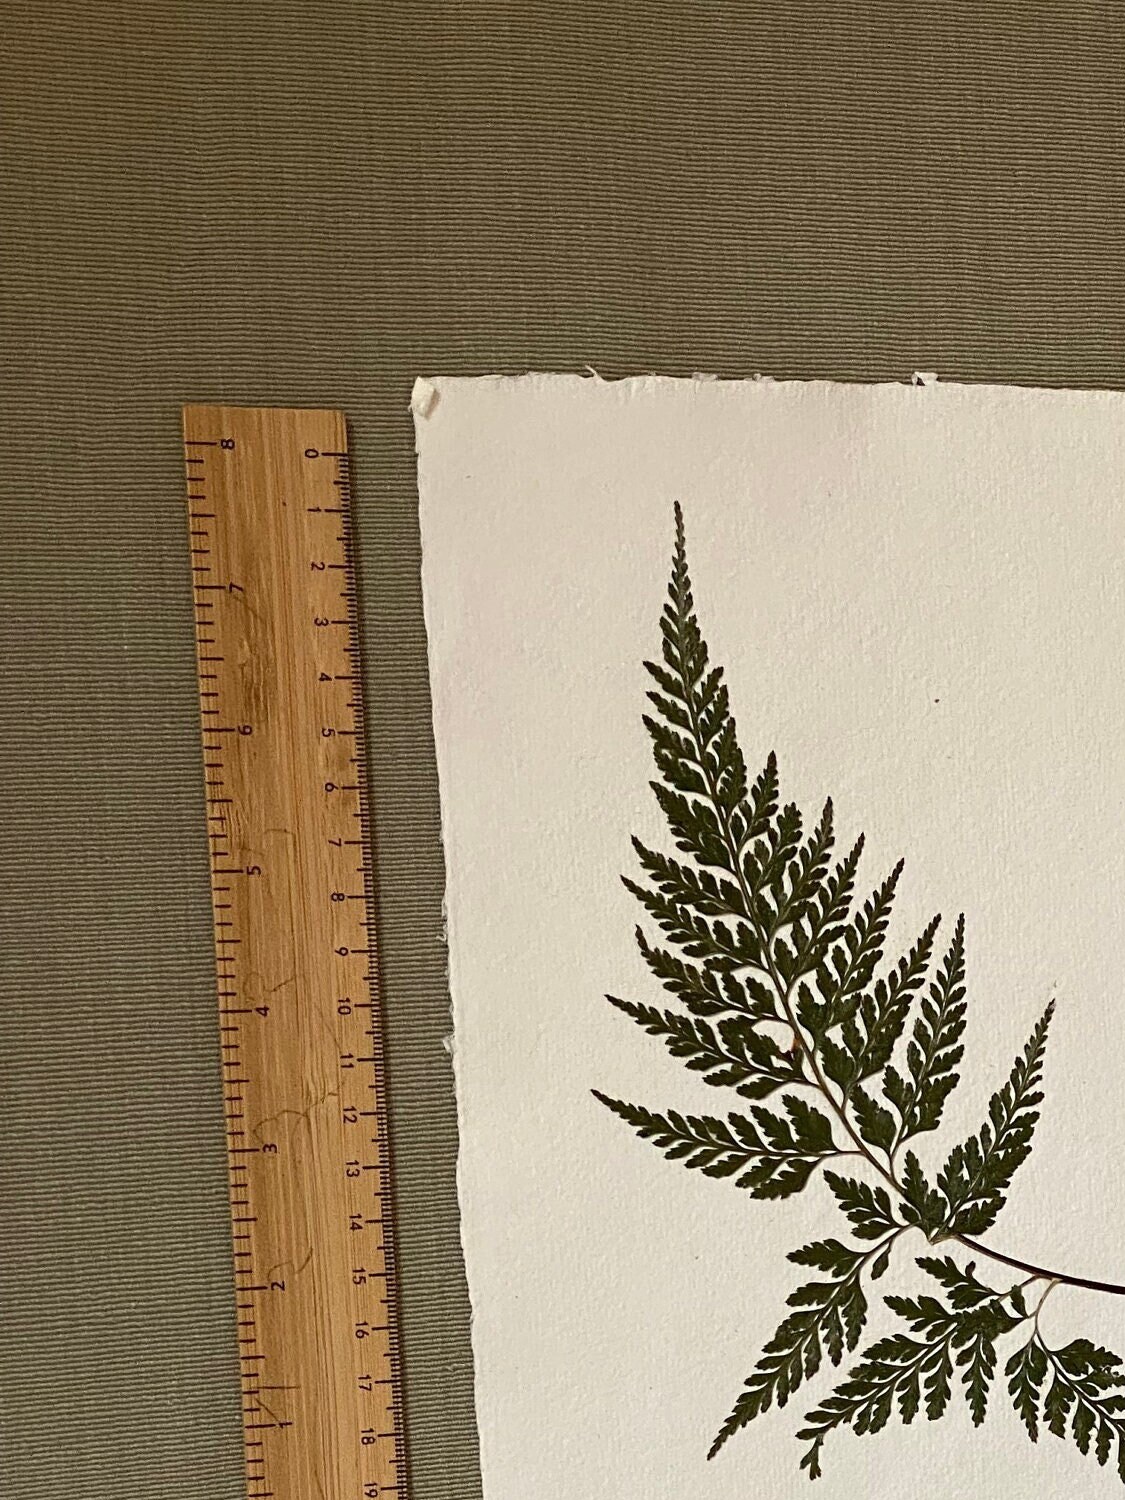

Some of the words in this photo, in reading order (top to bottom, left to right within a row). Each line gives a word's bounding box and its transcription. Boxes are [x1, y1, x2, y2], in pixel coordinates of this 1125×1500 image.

[219, 439, 236, 451] 8
[304, 447, 320, 459] 0
[310, 561, 326, 571] 2
[228, 581, 244, 593] 7
[313, 616, 330, 627] 3
[318, 672, 333, 682] 4
[237, 724, 253, 736] 6
[321, 727, 336, 738] 5
[324, 782, 339, 793] 6
[327, 837, 343, 848] 7
[246, 865, 262, 876] 5
[330, 890, 346, 903] 8
[334, 946, 349, 957] 9
[254, 1004, 270, 1018] 4
[337, 997, 352, 1016] 10
[339, 1052, 355, 1069] 11
[342, 1105, 358, 1125] 12
[261, 1143, 278, 1154] 3
[345, 1159, 361, 1178] 13
[348, 1213, 364, 1233] 14
[351, 1267, 367, 1286] 15
[270, 1280, 286, 1292] 2
[355, 1320, 370, 1340] 16
[357, 1374, 373, 1392] 17
[278, 1420, 293, 1429] 1
[360, 1427, 377, 1446] 18
[363, 1482, 379, 1499] 19
